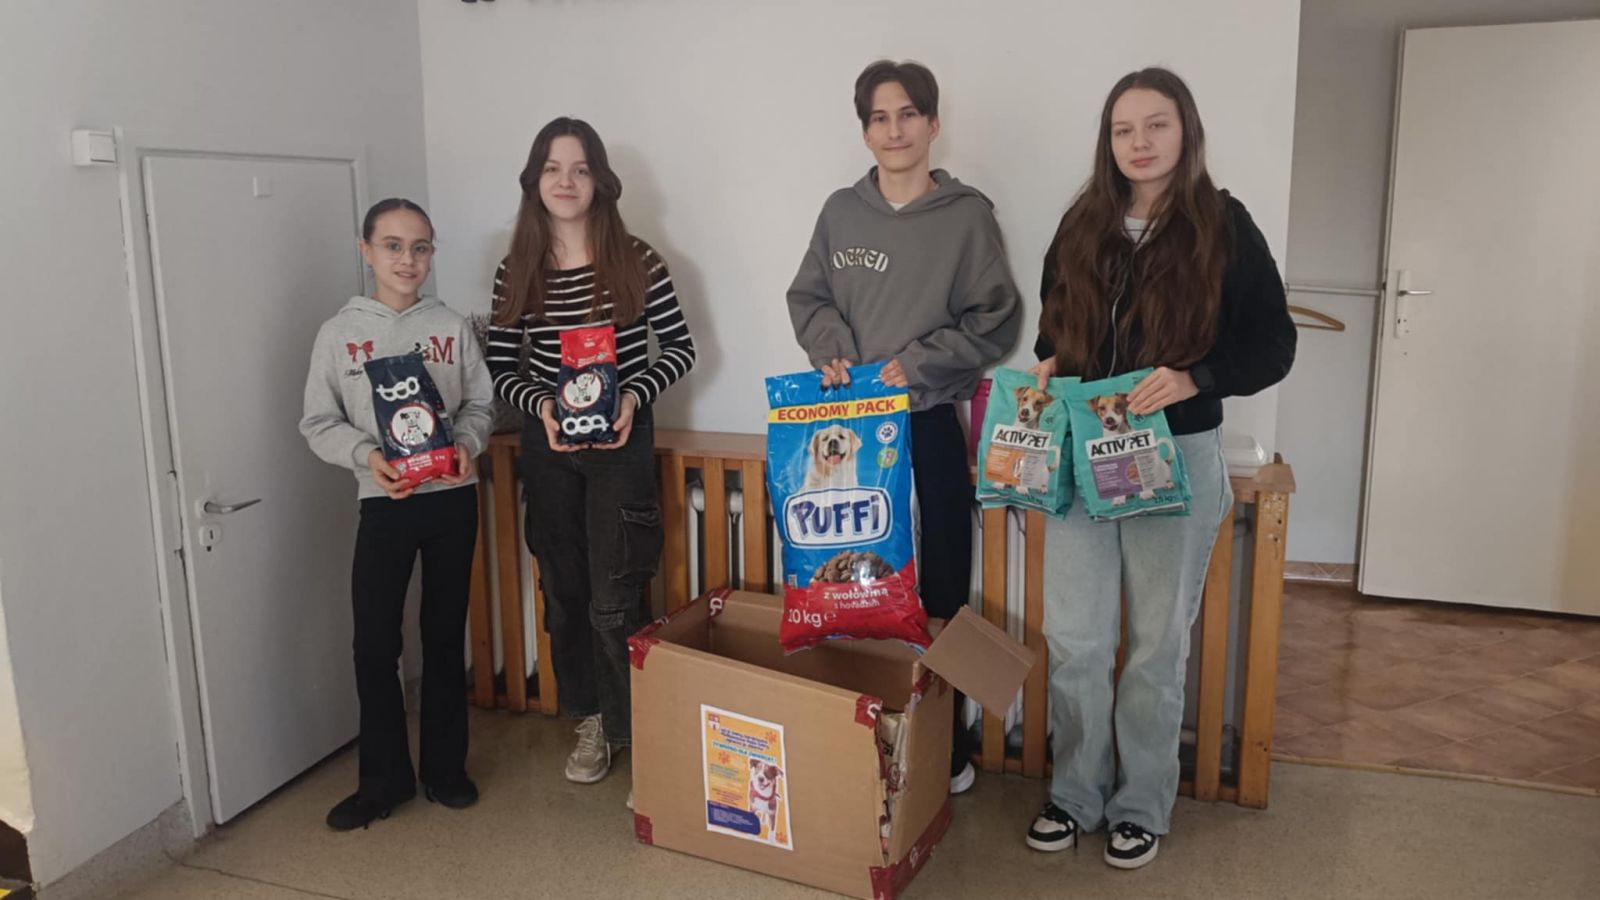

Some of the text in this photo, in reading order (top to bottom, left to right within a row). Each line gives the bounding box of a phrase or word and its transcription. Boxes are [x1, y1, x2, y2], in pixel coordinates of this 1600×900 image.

[832, 248, 889, 272] OCKED
[429, 336, 455, 364] M
[777, 398, 896, 421] ECONOMY PACK
[787, 610, 801, 624] 10
[803, 610, 822, 627] kg
